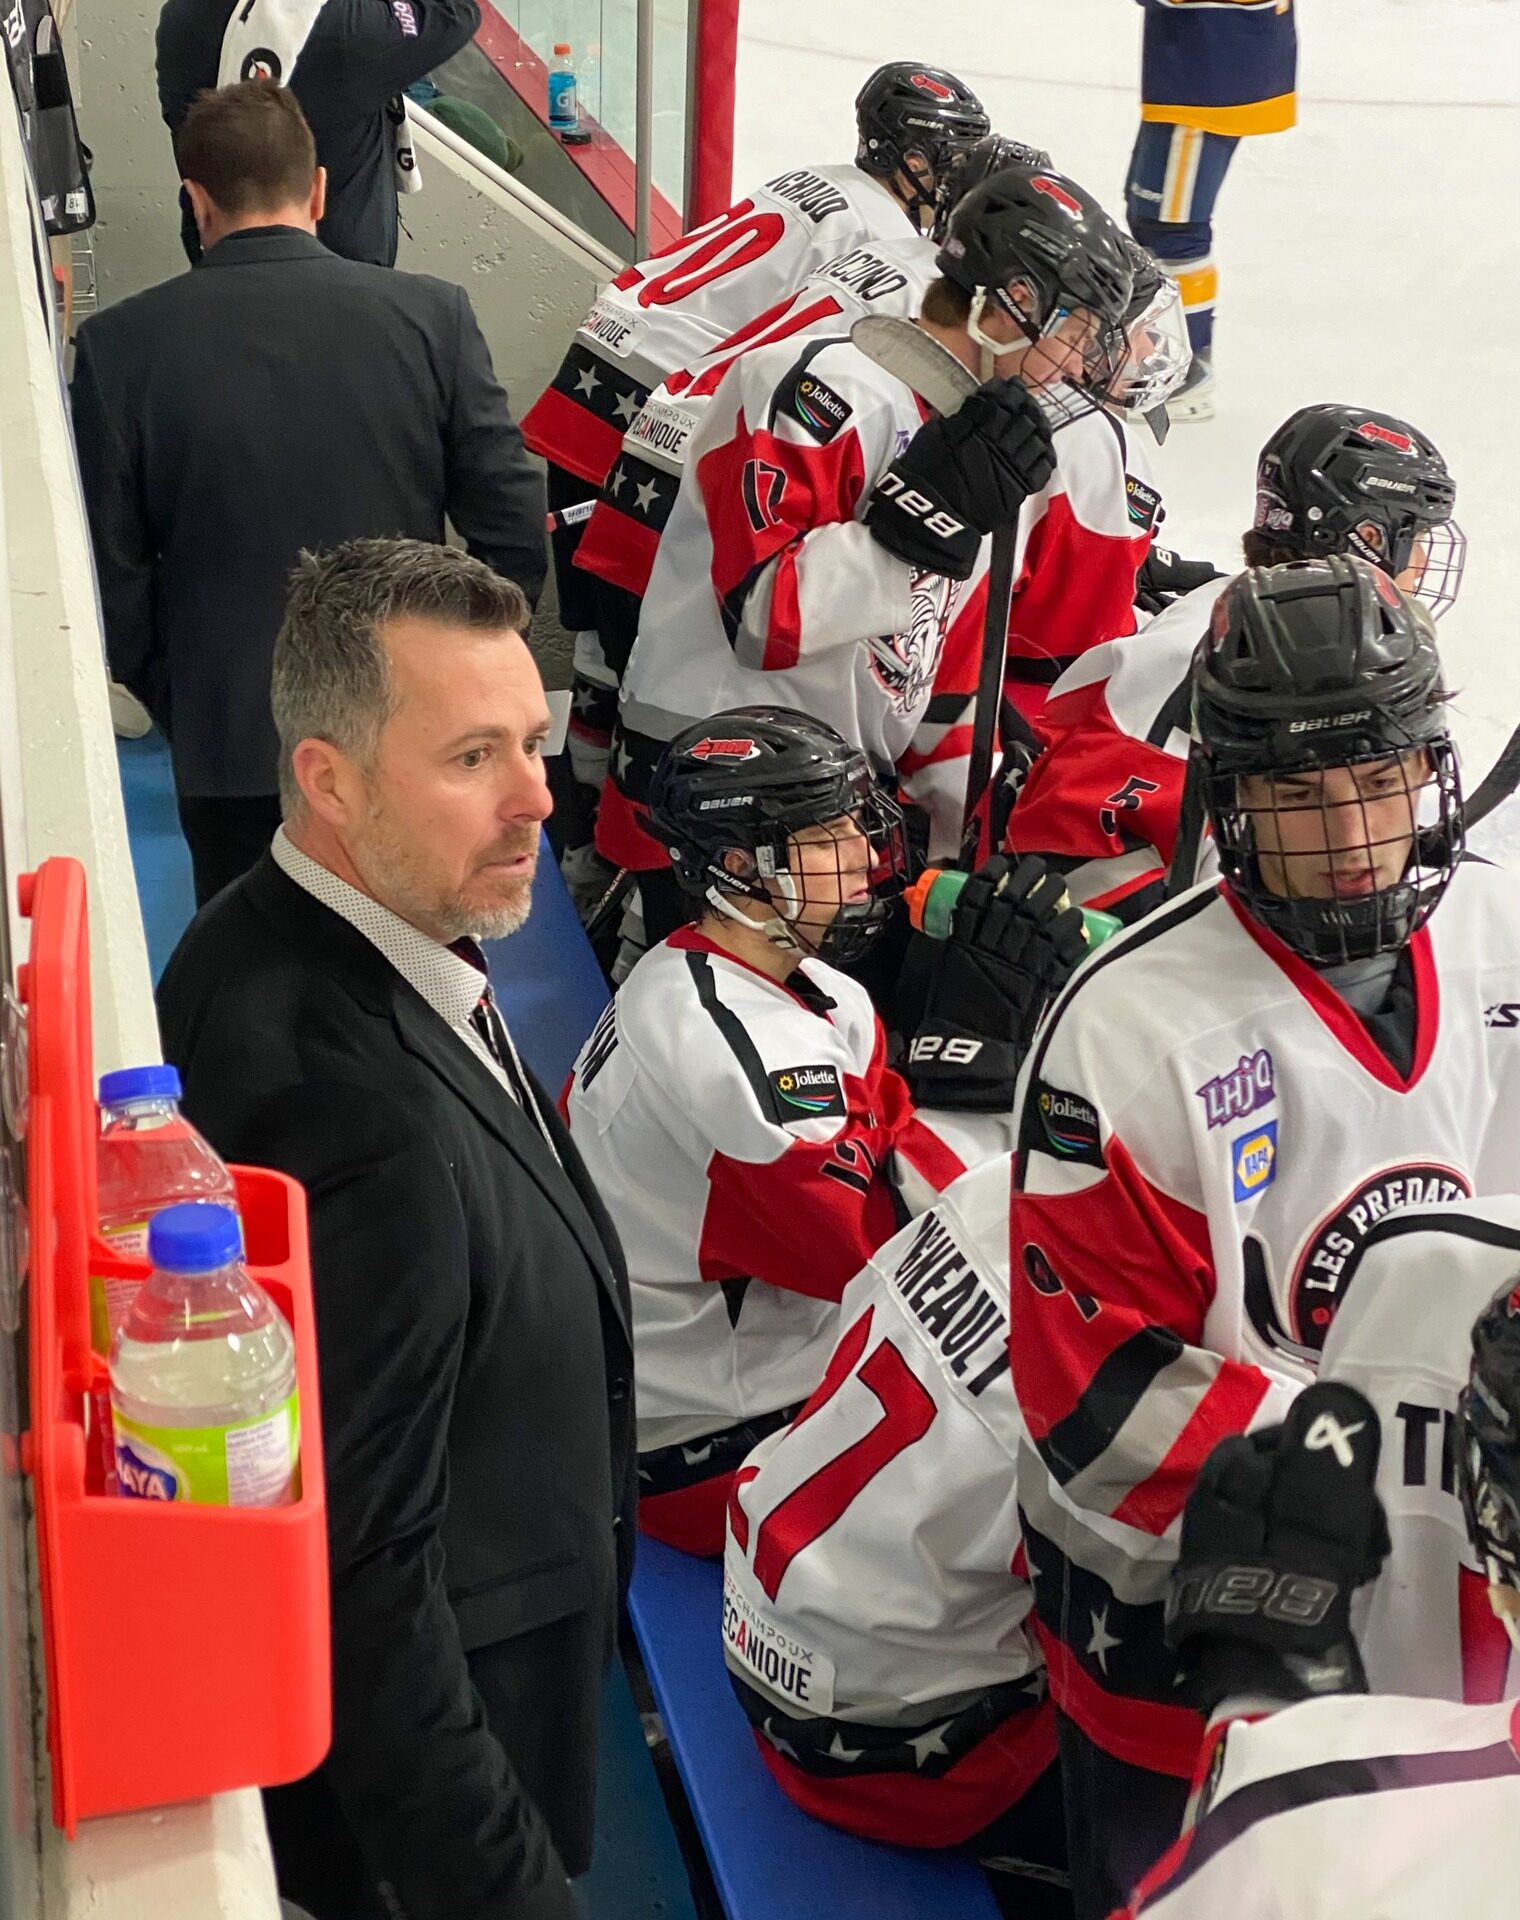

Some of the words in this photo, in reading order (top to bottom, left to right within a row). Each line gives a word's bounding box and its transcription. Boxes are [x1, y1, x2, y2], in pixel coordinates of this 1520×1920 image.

[396, 147, 415, 171] G
[996, 287, 1028, 323] BAUER
[810, 384, 845, 420] Joliette
[742, 459, 788, 533] 17
[1133, 483, 1157, 505] Joliette
[1366, 476, 1417, 494] BAUER
[1348, 532, 1381, 564] BAUER
[1289, 710, 1372, 733] BAUER
[699, 796, 754, 811] BAUER
[1099, 774, 1160, 836] 5
[707, 865, 751, 892] BAUER
[793, 1069, 836, 1089] Joliette
[1244, 1146, 1269, 1179] NAPA
[1305, 1231, 1355, 1293] LES
[1023, 1243, 1102, 1323] 9
